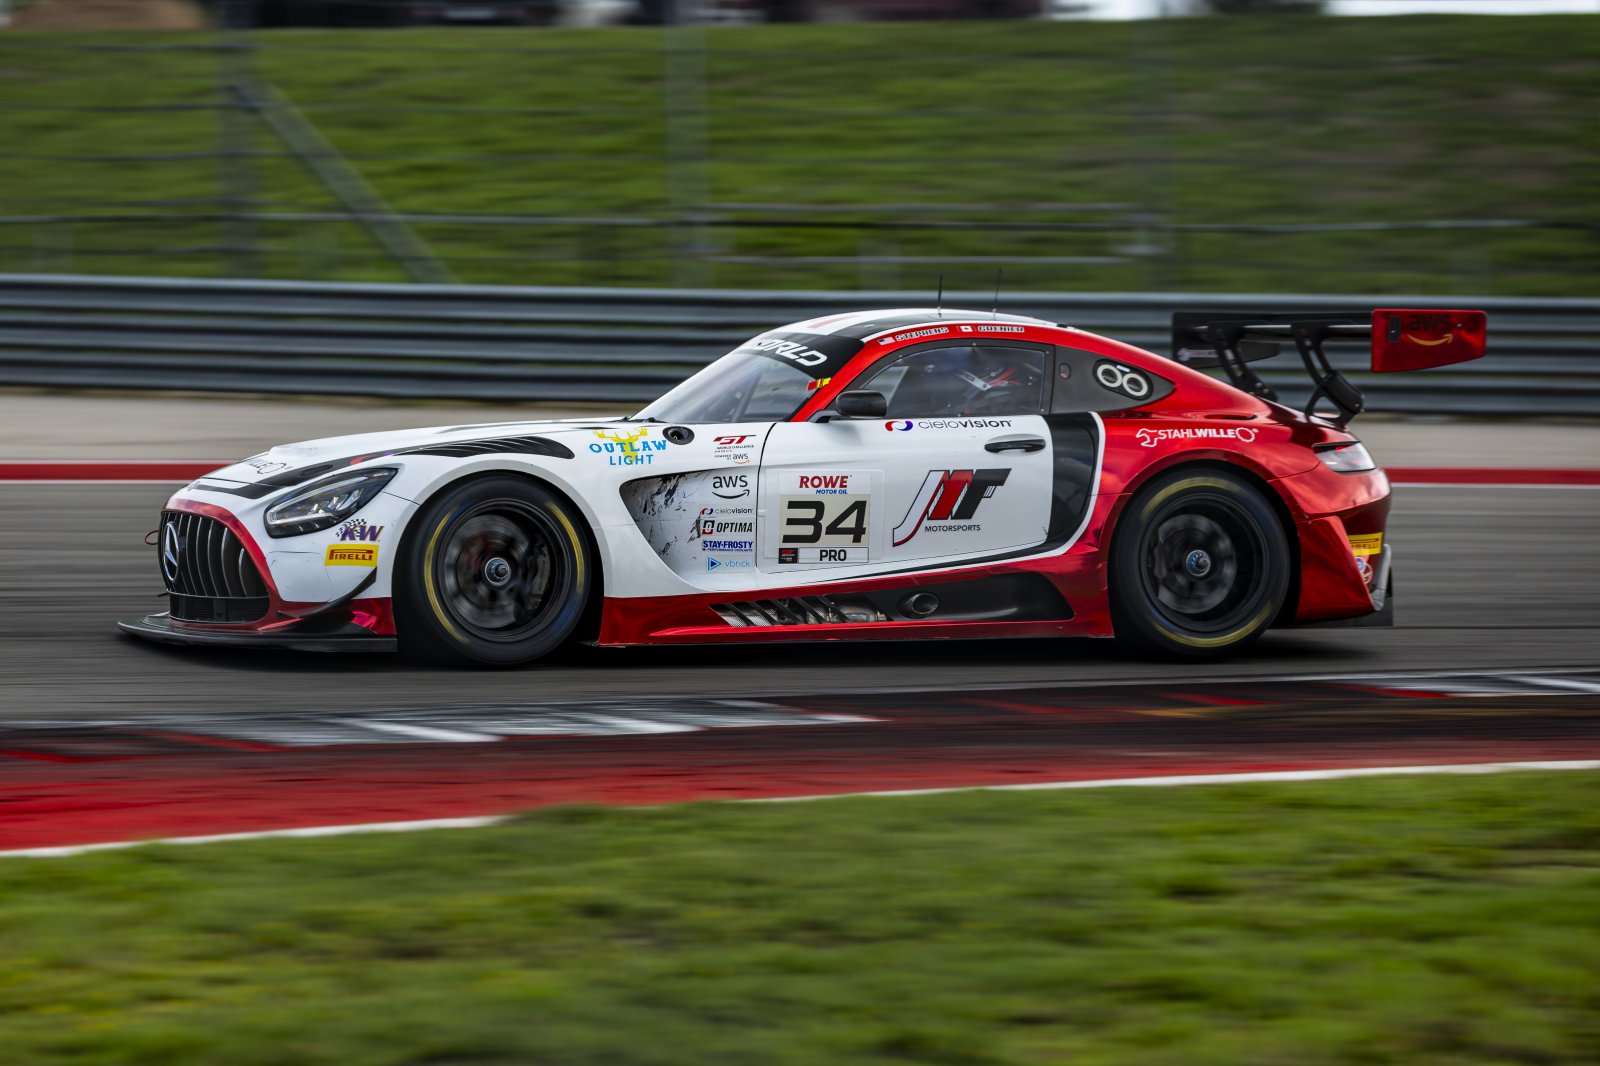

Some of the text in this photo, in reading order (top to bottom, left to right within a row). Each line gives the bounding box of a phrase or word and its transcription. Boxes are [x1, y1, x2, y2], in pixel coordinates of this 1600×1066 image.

[1408, 314, 1450, 331] aws
[896, 327, 949, 341] STEPHENS
[918, 418, 1012, 430] cielovision
[713, 434, 756, 445] GT
[1158, 427, 1236, 440] STAHLWILLE
[589, 440, 667, 453] OUTLAW
[609, 454, 654, 466] LIGHT
[712, 475, 748, 489] aws
[799, 475, 849, 489] ROWE
[715, 507, 753, 515] cielovision
[717, 522, 752, 532] OPTIMA
[782, 500, 867, 544] 34
[925, 524, 981, 533] MOTORSPORTS
[340, 524, 384, 541] KW
[703, 540, 753, 548] STAY-FROSTY
[329, 548, 373, 561] PIRELLI
[819, 549, 847, 562] PRO
